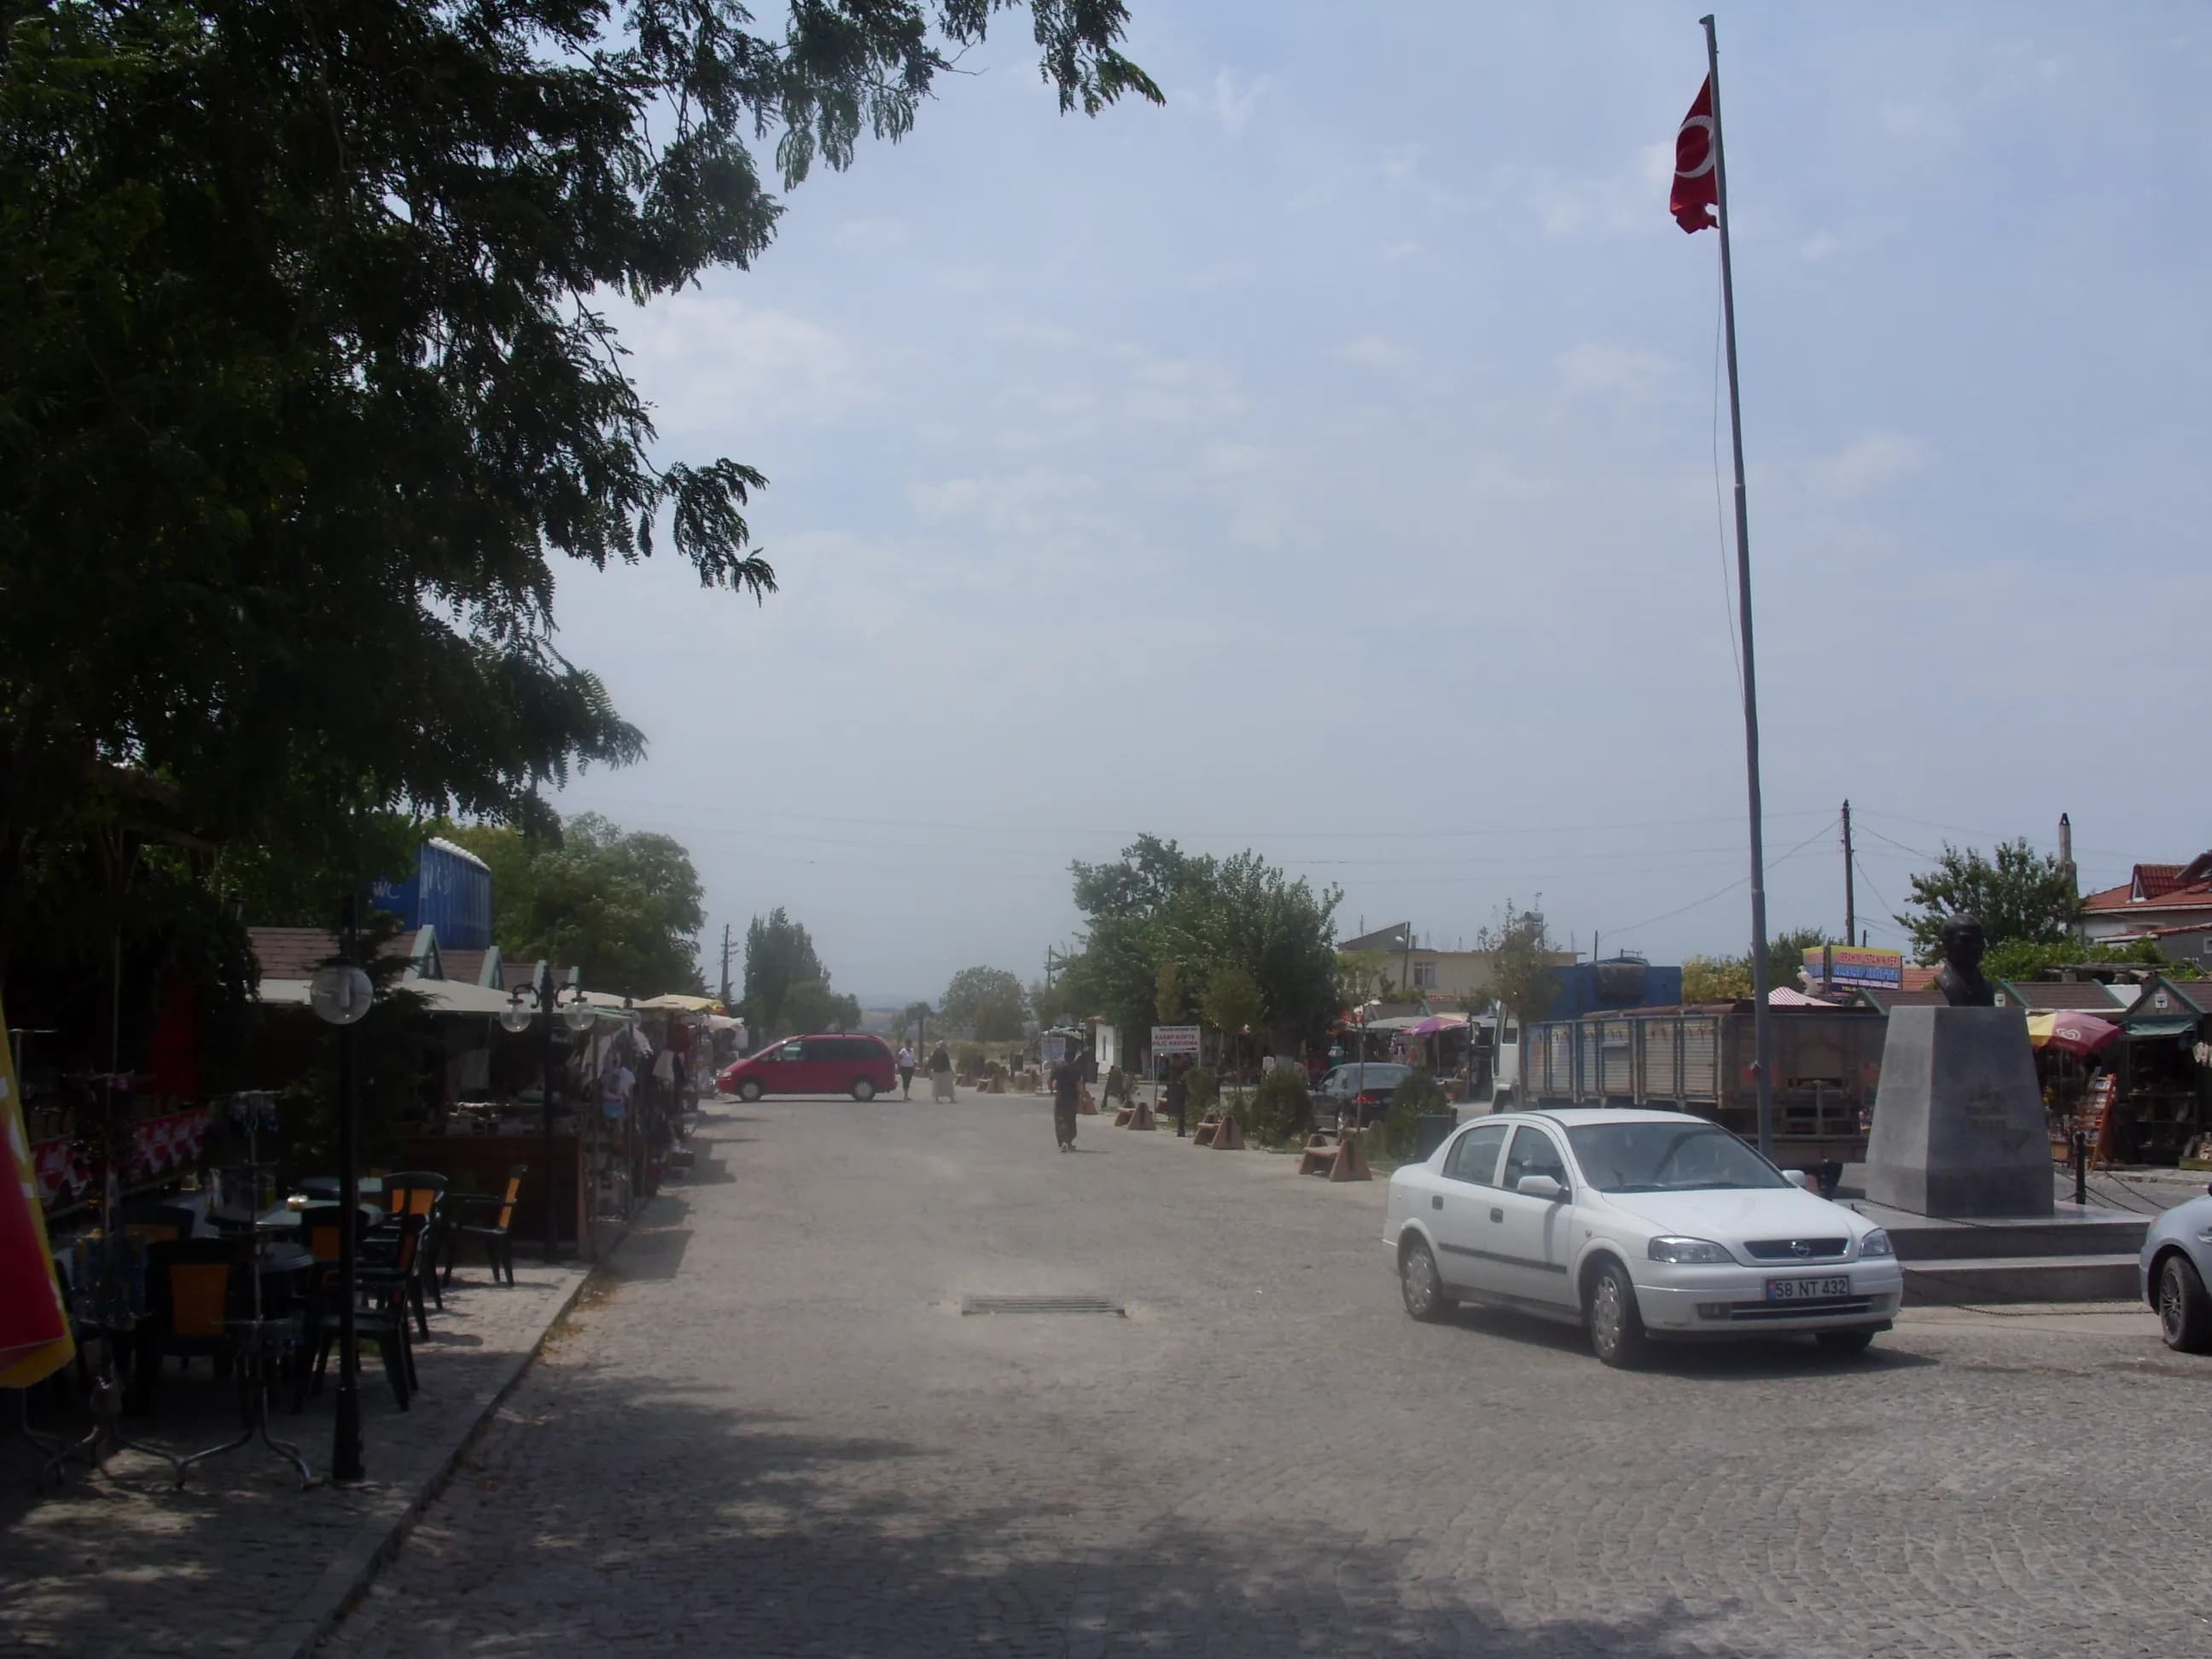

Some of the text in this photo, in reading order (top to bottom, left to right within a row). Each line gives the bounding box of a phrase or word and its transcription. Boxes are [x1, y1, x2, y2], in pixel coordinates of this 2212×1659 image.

[1775, 1279, 1846, 1298] 58 NT 432
